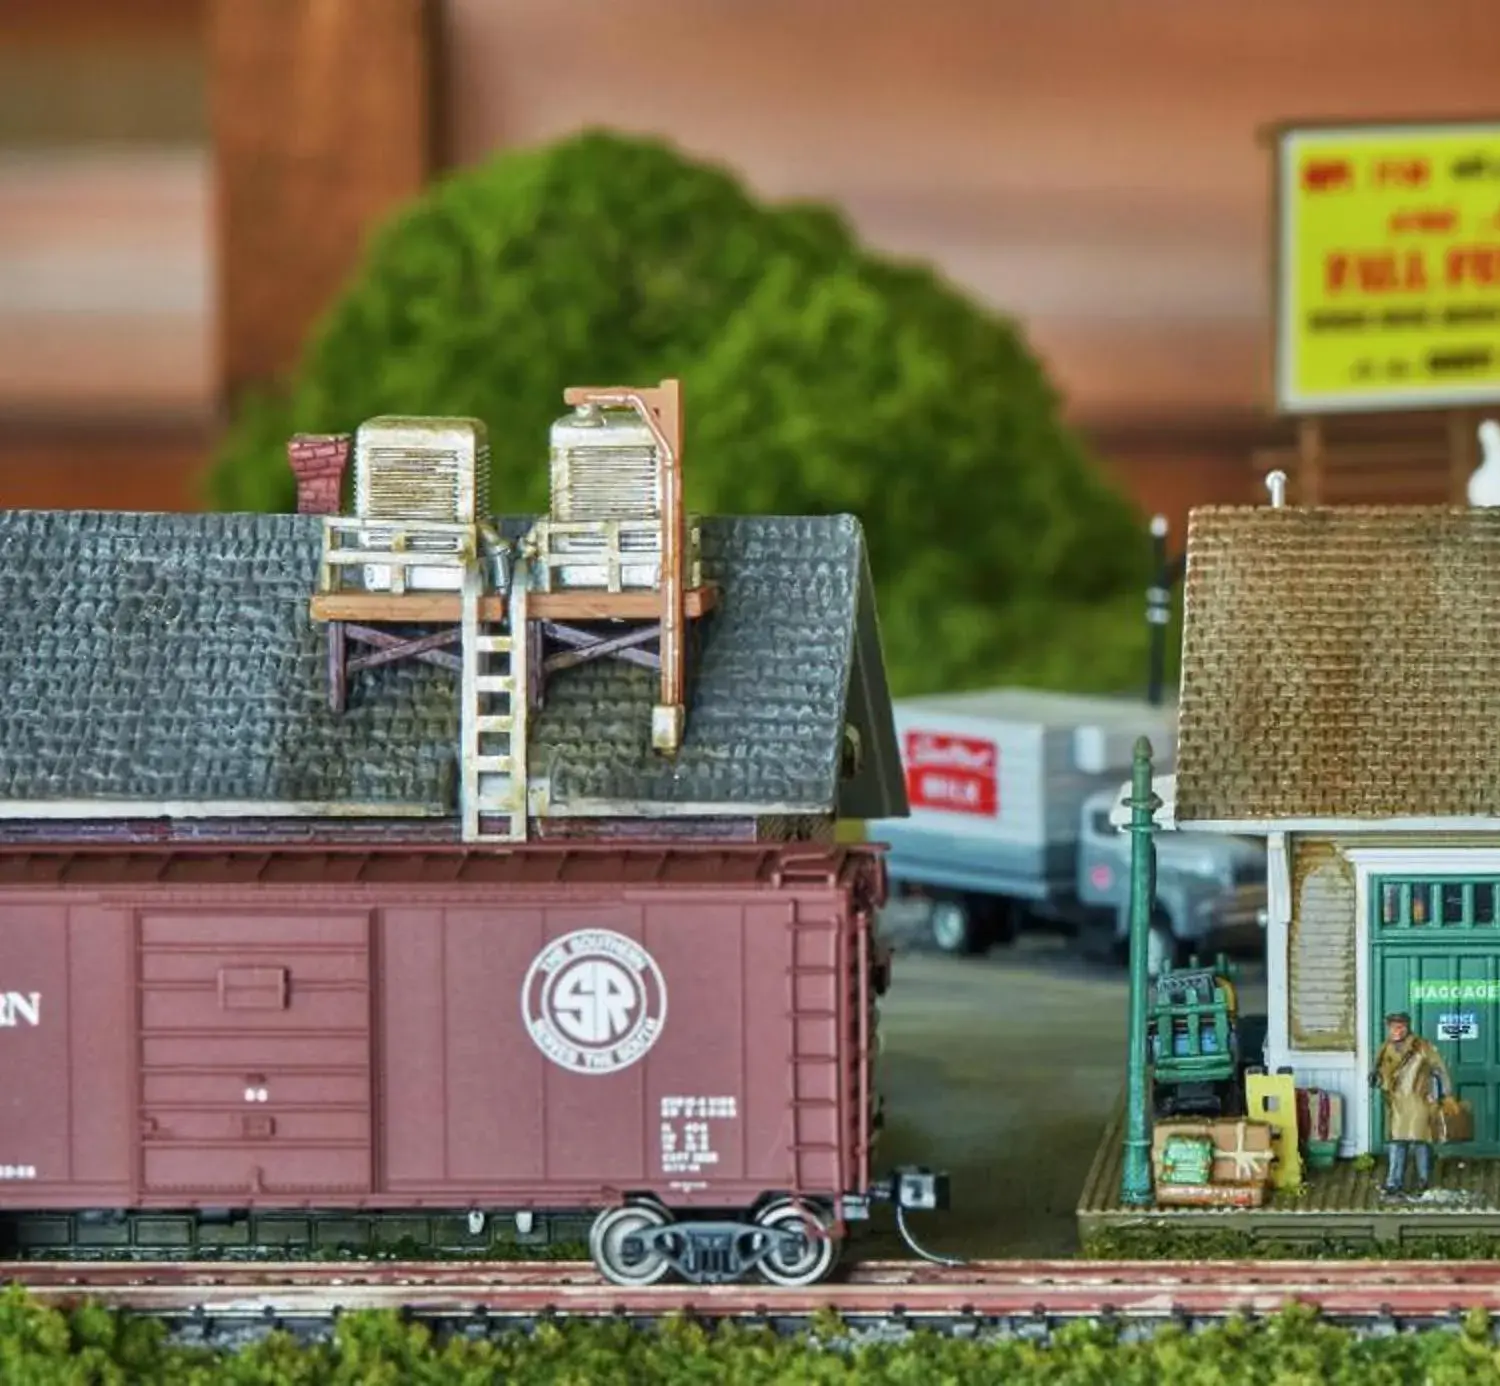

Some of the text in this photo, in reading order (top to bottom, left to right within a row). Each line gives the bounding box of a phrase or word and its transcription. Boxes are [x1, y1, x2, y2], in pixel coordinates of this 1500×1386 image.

[1326, 250, 1428, 293] FALL
[922, 772, 980, 804] MILK
[569, 932, 649, 972] SOUTHERN
[553, 960, 637, 1042] SR
